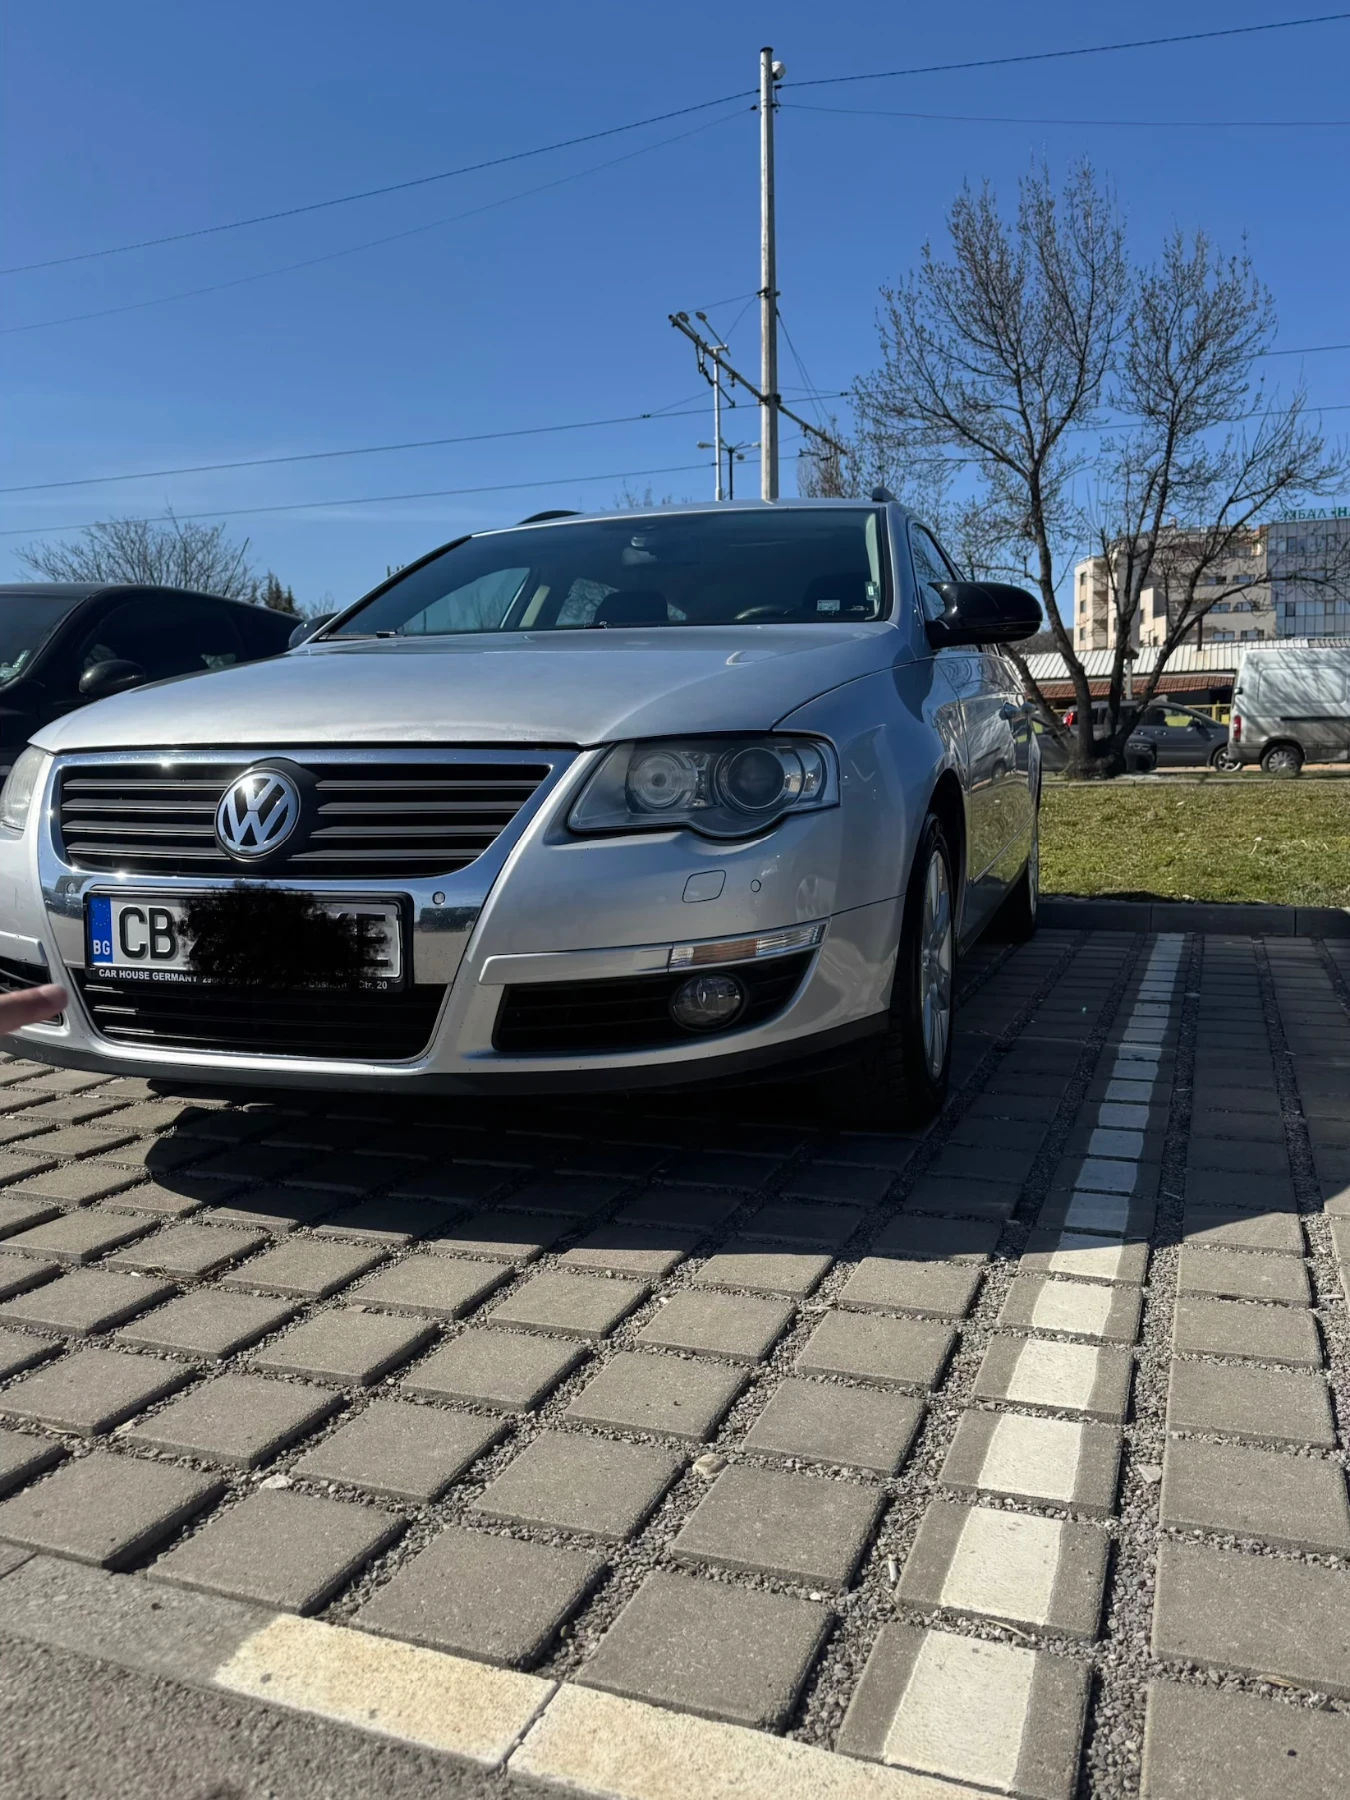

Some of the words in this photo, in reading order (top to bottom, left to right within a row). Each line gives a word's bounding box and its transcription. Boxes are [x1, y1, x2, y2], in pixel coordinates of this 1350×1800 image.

[218, 773, 297, 854] VW
[93, 939, 111, 955] BG
[98, 968, 117, 979] CAR
[119, 970, 150, 981] HOUSE
[152, 972, 198, 983] GERMANY
[376, 980, 388, 990] 20
